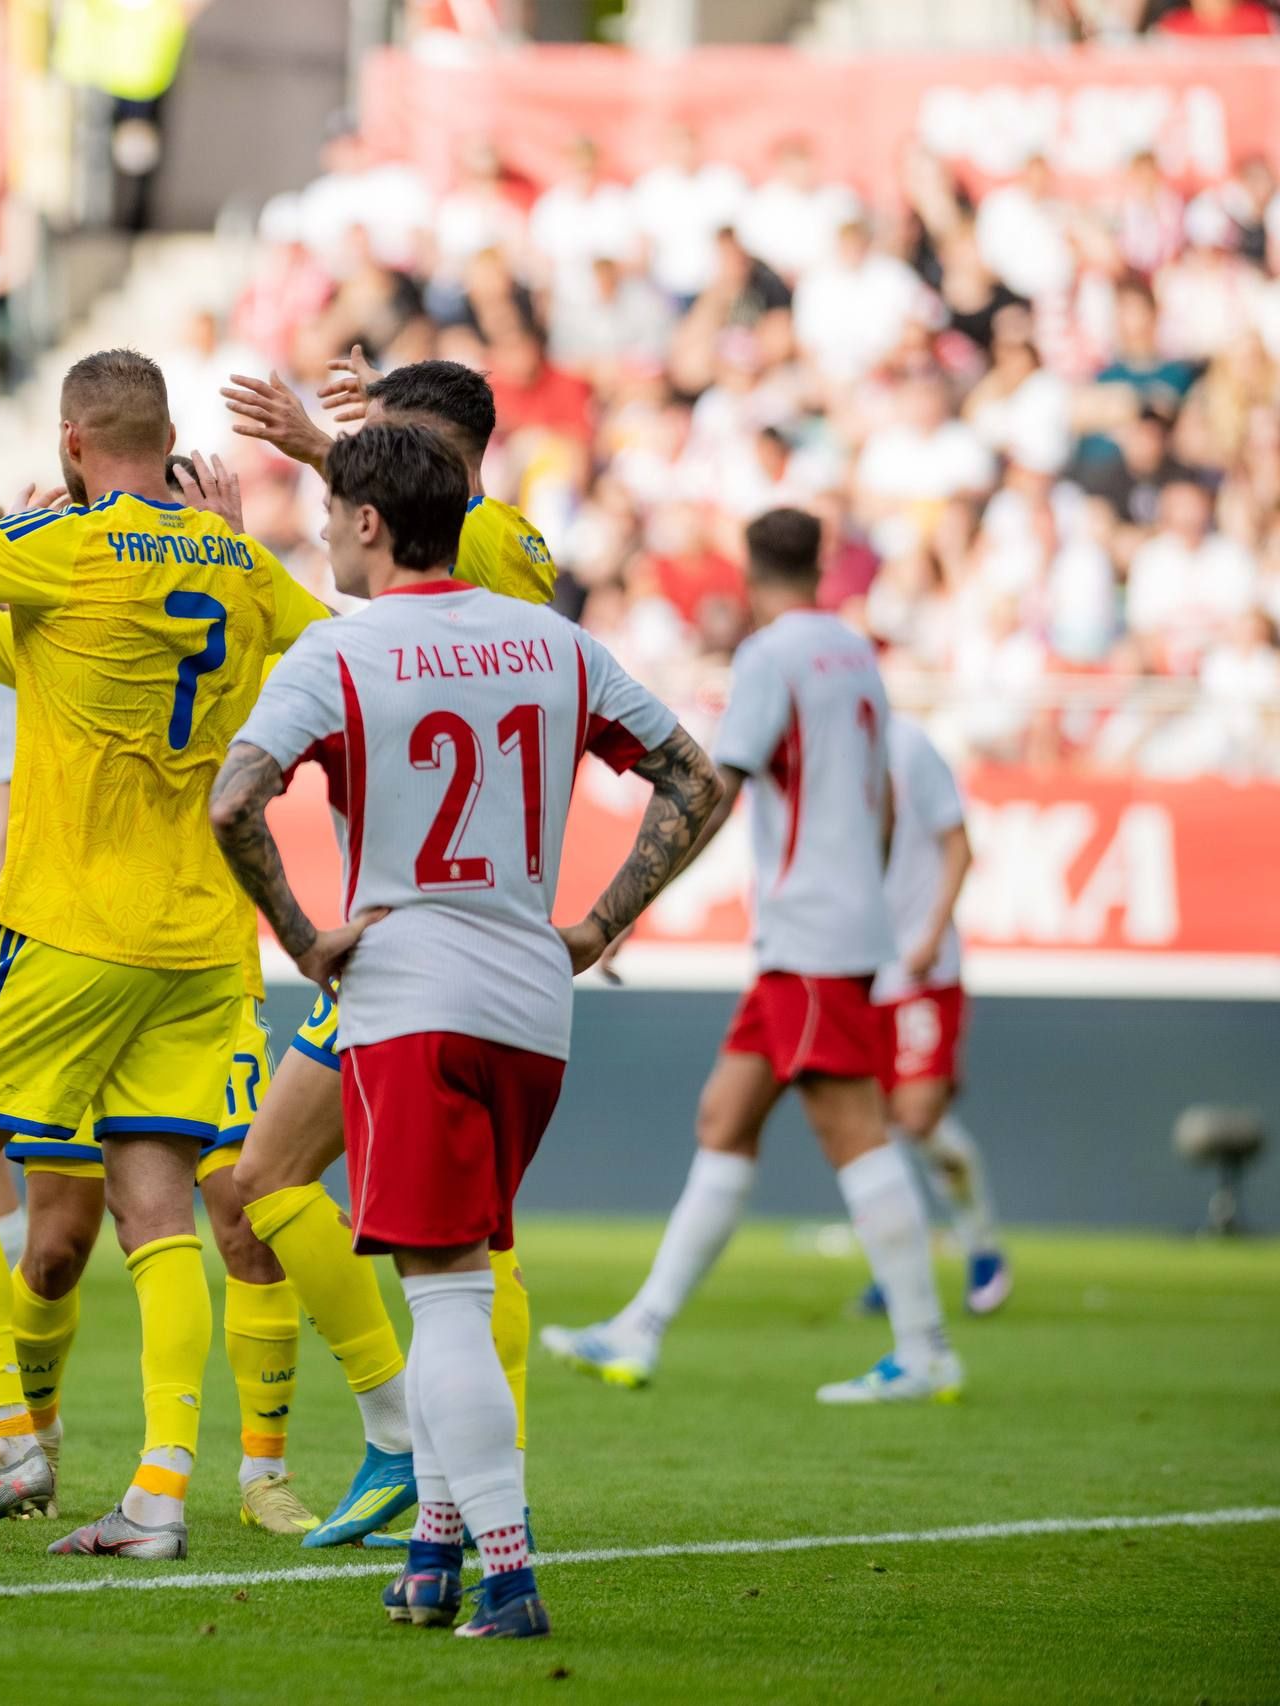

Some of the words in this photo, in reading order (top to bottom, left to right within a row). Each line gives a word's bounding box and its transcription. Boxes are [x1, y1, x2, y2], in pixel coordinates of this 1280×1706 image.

[164, 590, 227, 750] 7
[389, 638, 554, 681] ZALEWSKI
[408, 704, 547, 892] 21
[261, 1366, 296, 1384] UAF
